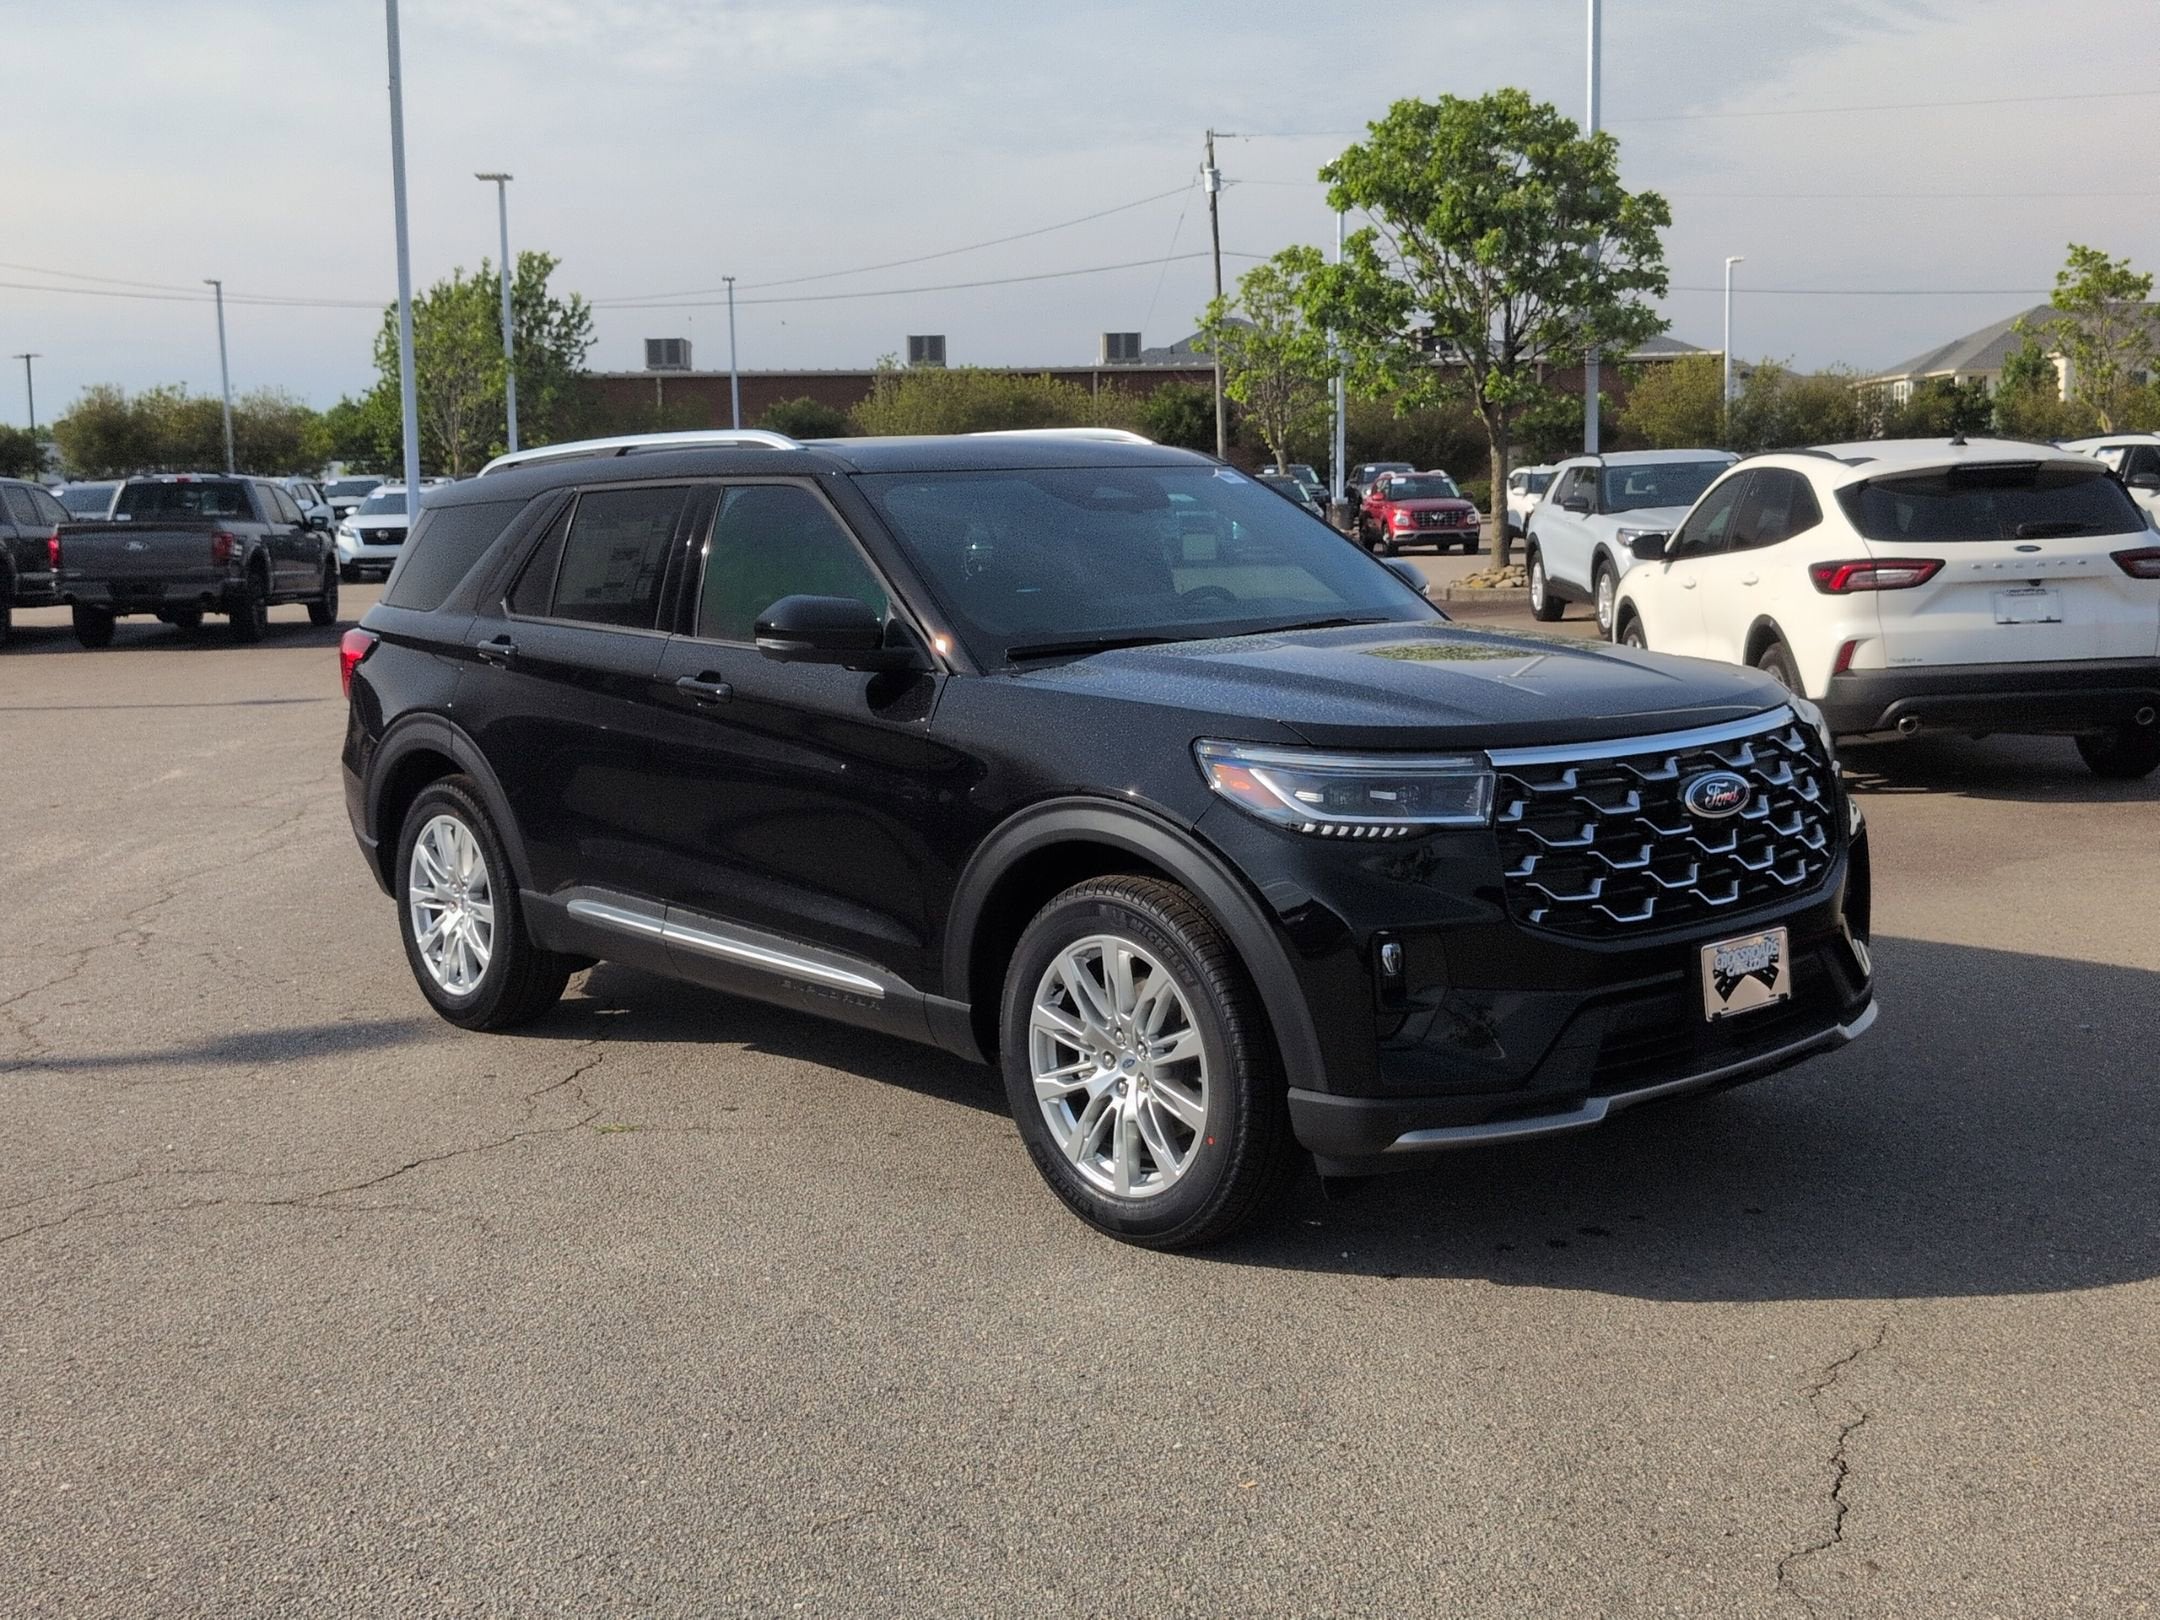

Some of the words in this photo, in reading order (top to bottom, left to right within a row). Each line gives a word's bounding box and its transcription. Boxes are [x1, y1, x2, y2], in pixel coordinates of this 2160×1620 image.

[1704, 781, 1739, 808] Ford
[1128, 917, 1195, 988] MICHELIN
[1714, 941, 1779, 971] CROSSROADS
